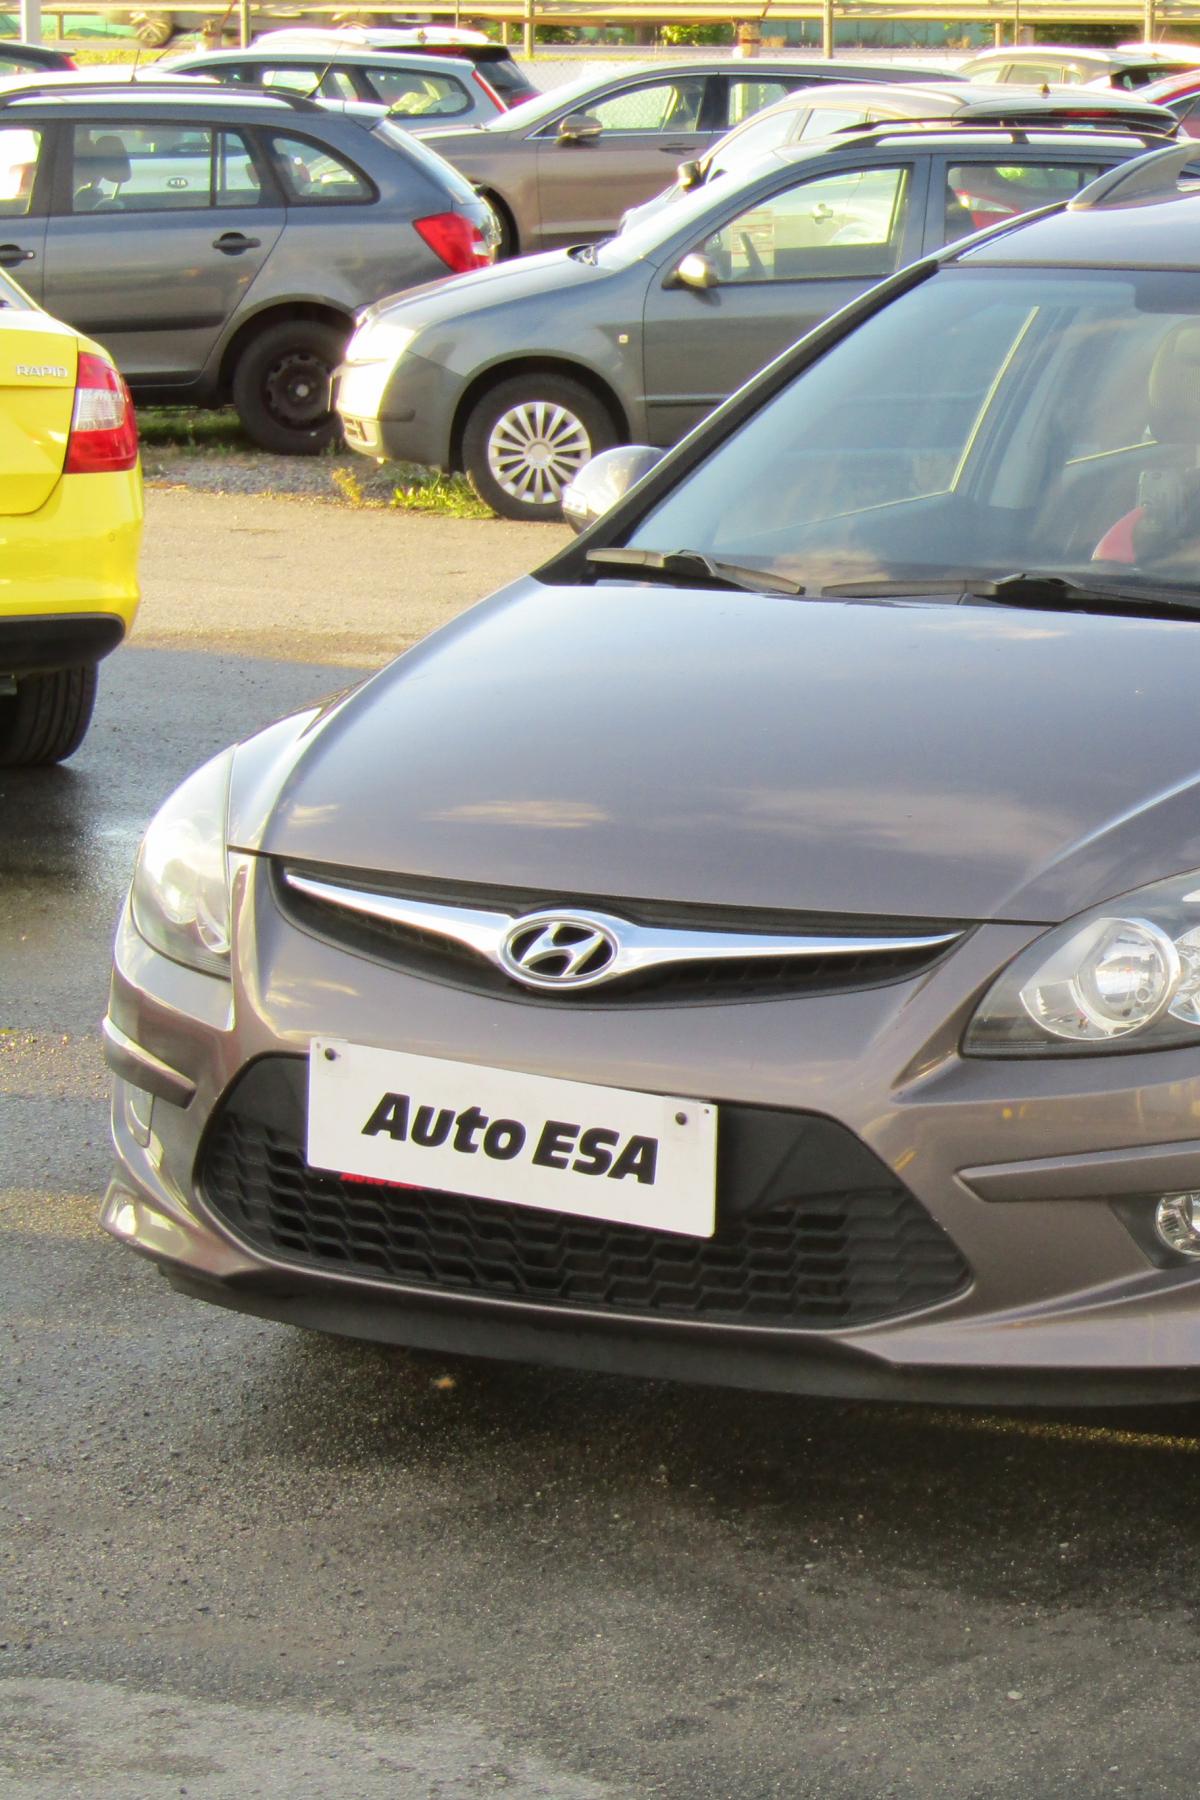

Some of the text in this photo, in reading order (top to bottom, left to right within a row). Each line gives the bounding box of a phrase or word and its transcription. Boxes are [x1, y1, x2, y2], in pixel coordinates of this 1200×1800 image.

[16, 365, 68, 378] RAPID
[361, 1092, 659, 1185] Auto ESA
